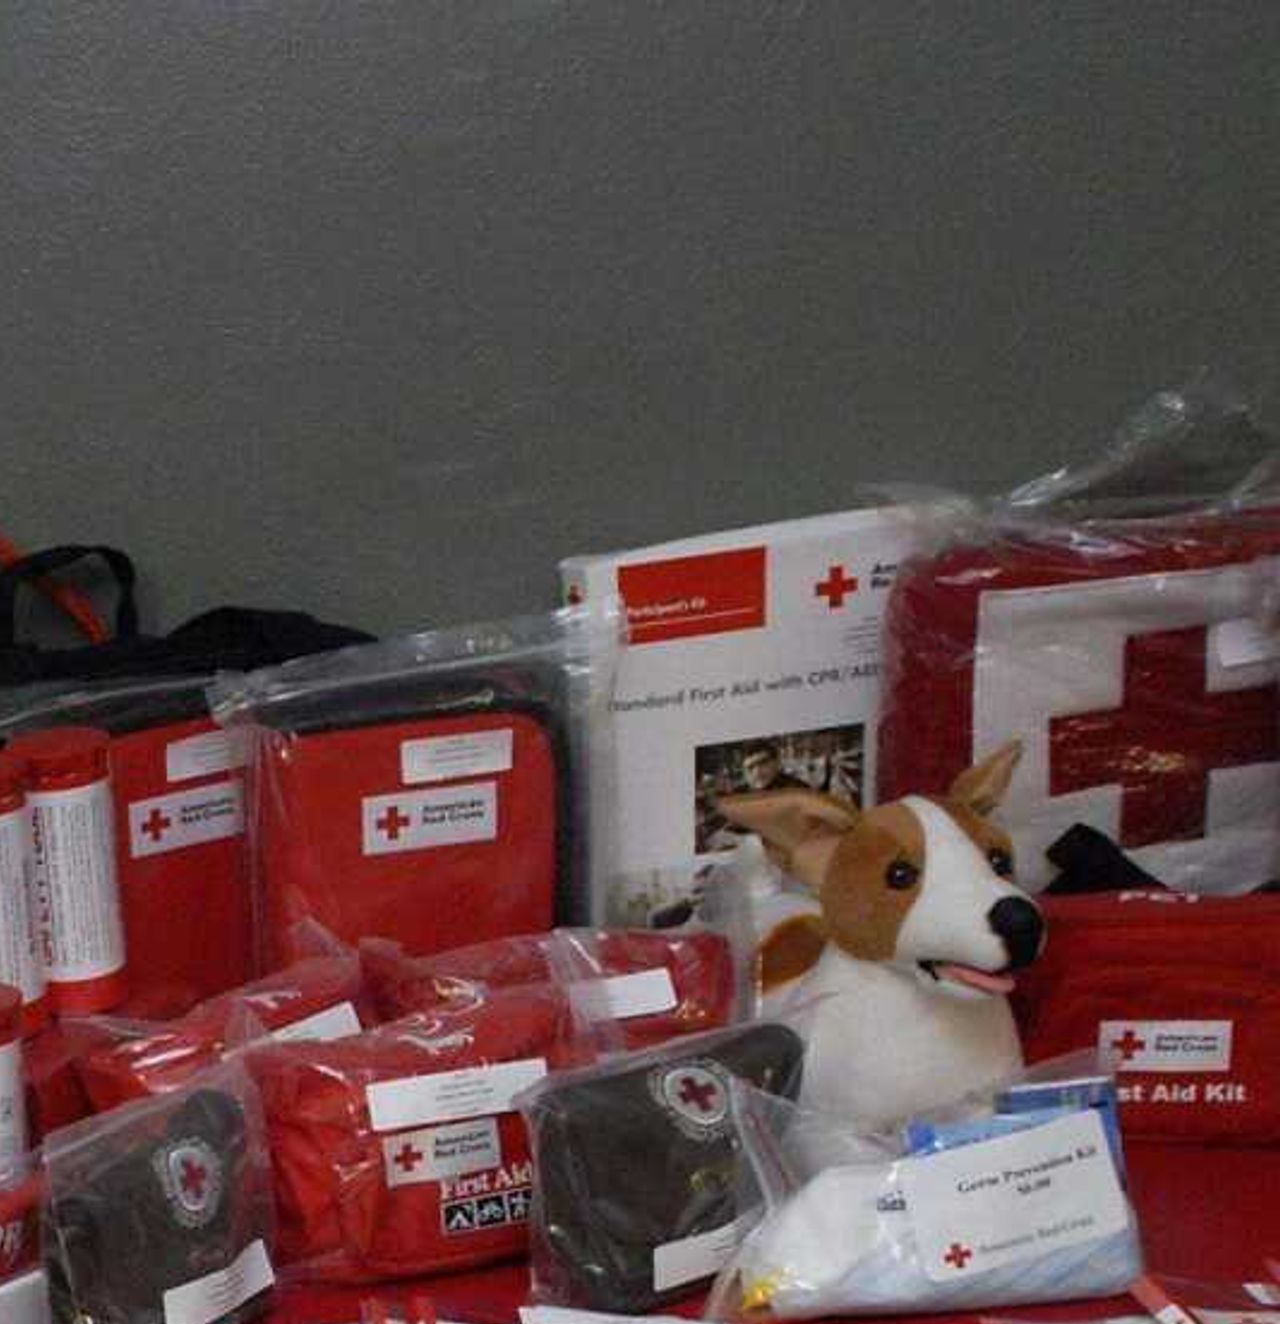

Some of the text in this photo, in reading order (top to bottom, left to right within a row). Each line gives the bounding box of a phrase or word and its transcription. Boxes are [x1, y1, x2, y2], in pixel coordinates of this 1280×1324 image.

[690, 687, 725, 702] First
[730, 679, 760, 696] Aid
[765, 672, 801, 692] with
[422, 813, 446, 824] Red
[1152, 1083, 1197, 1103] Aid
[1204, 1083, 1247, 1103] Kit
